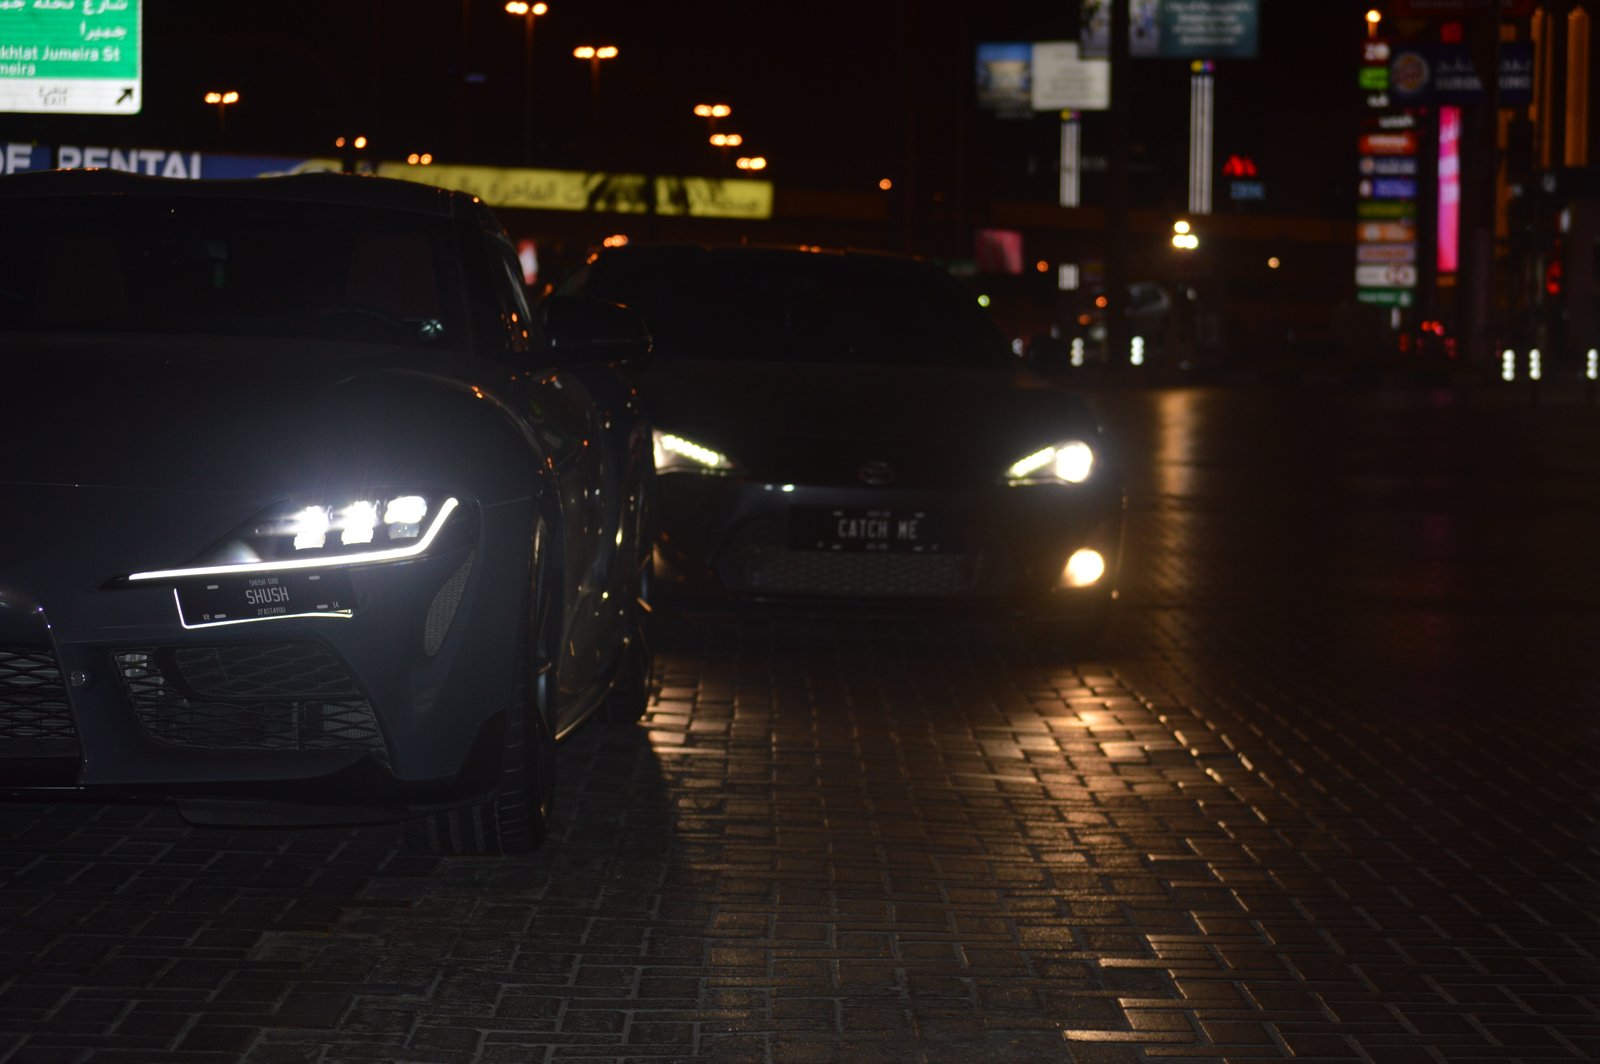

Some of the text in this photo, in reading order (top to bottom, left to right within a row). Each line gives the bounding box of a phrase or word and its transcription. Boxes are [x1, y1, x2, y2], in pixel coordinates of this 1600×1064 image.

[81, 21, 127, 41] جميرا
[42, 45, 98, 61] Jumeira
[103, 46, 120, 61] St
[838, 517, 919, 540] CATCH ME
[245, 586, 290, 605] SHUSH
